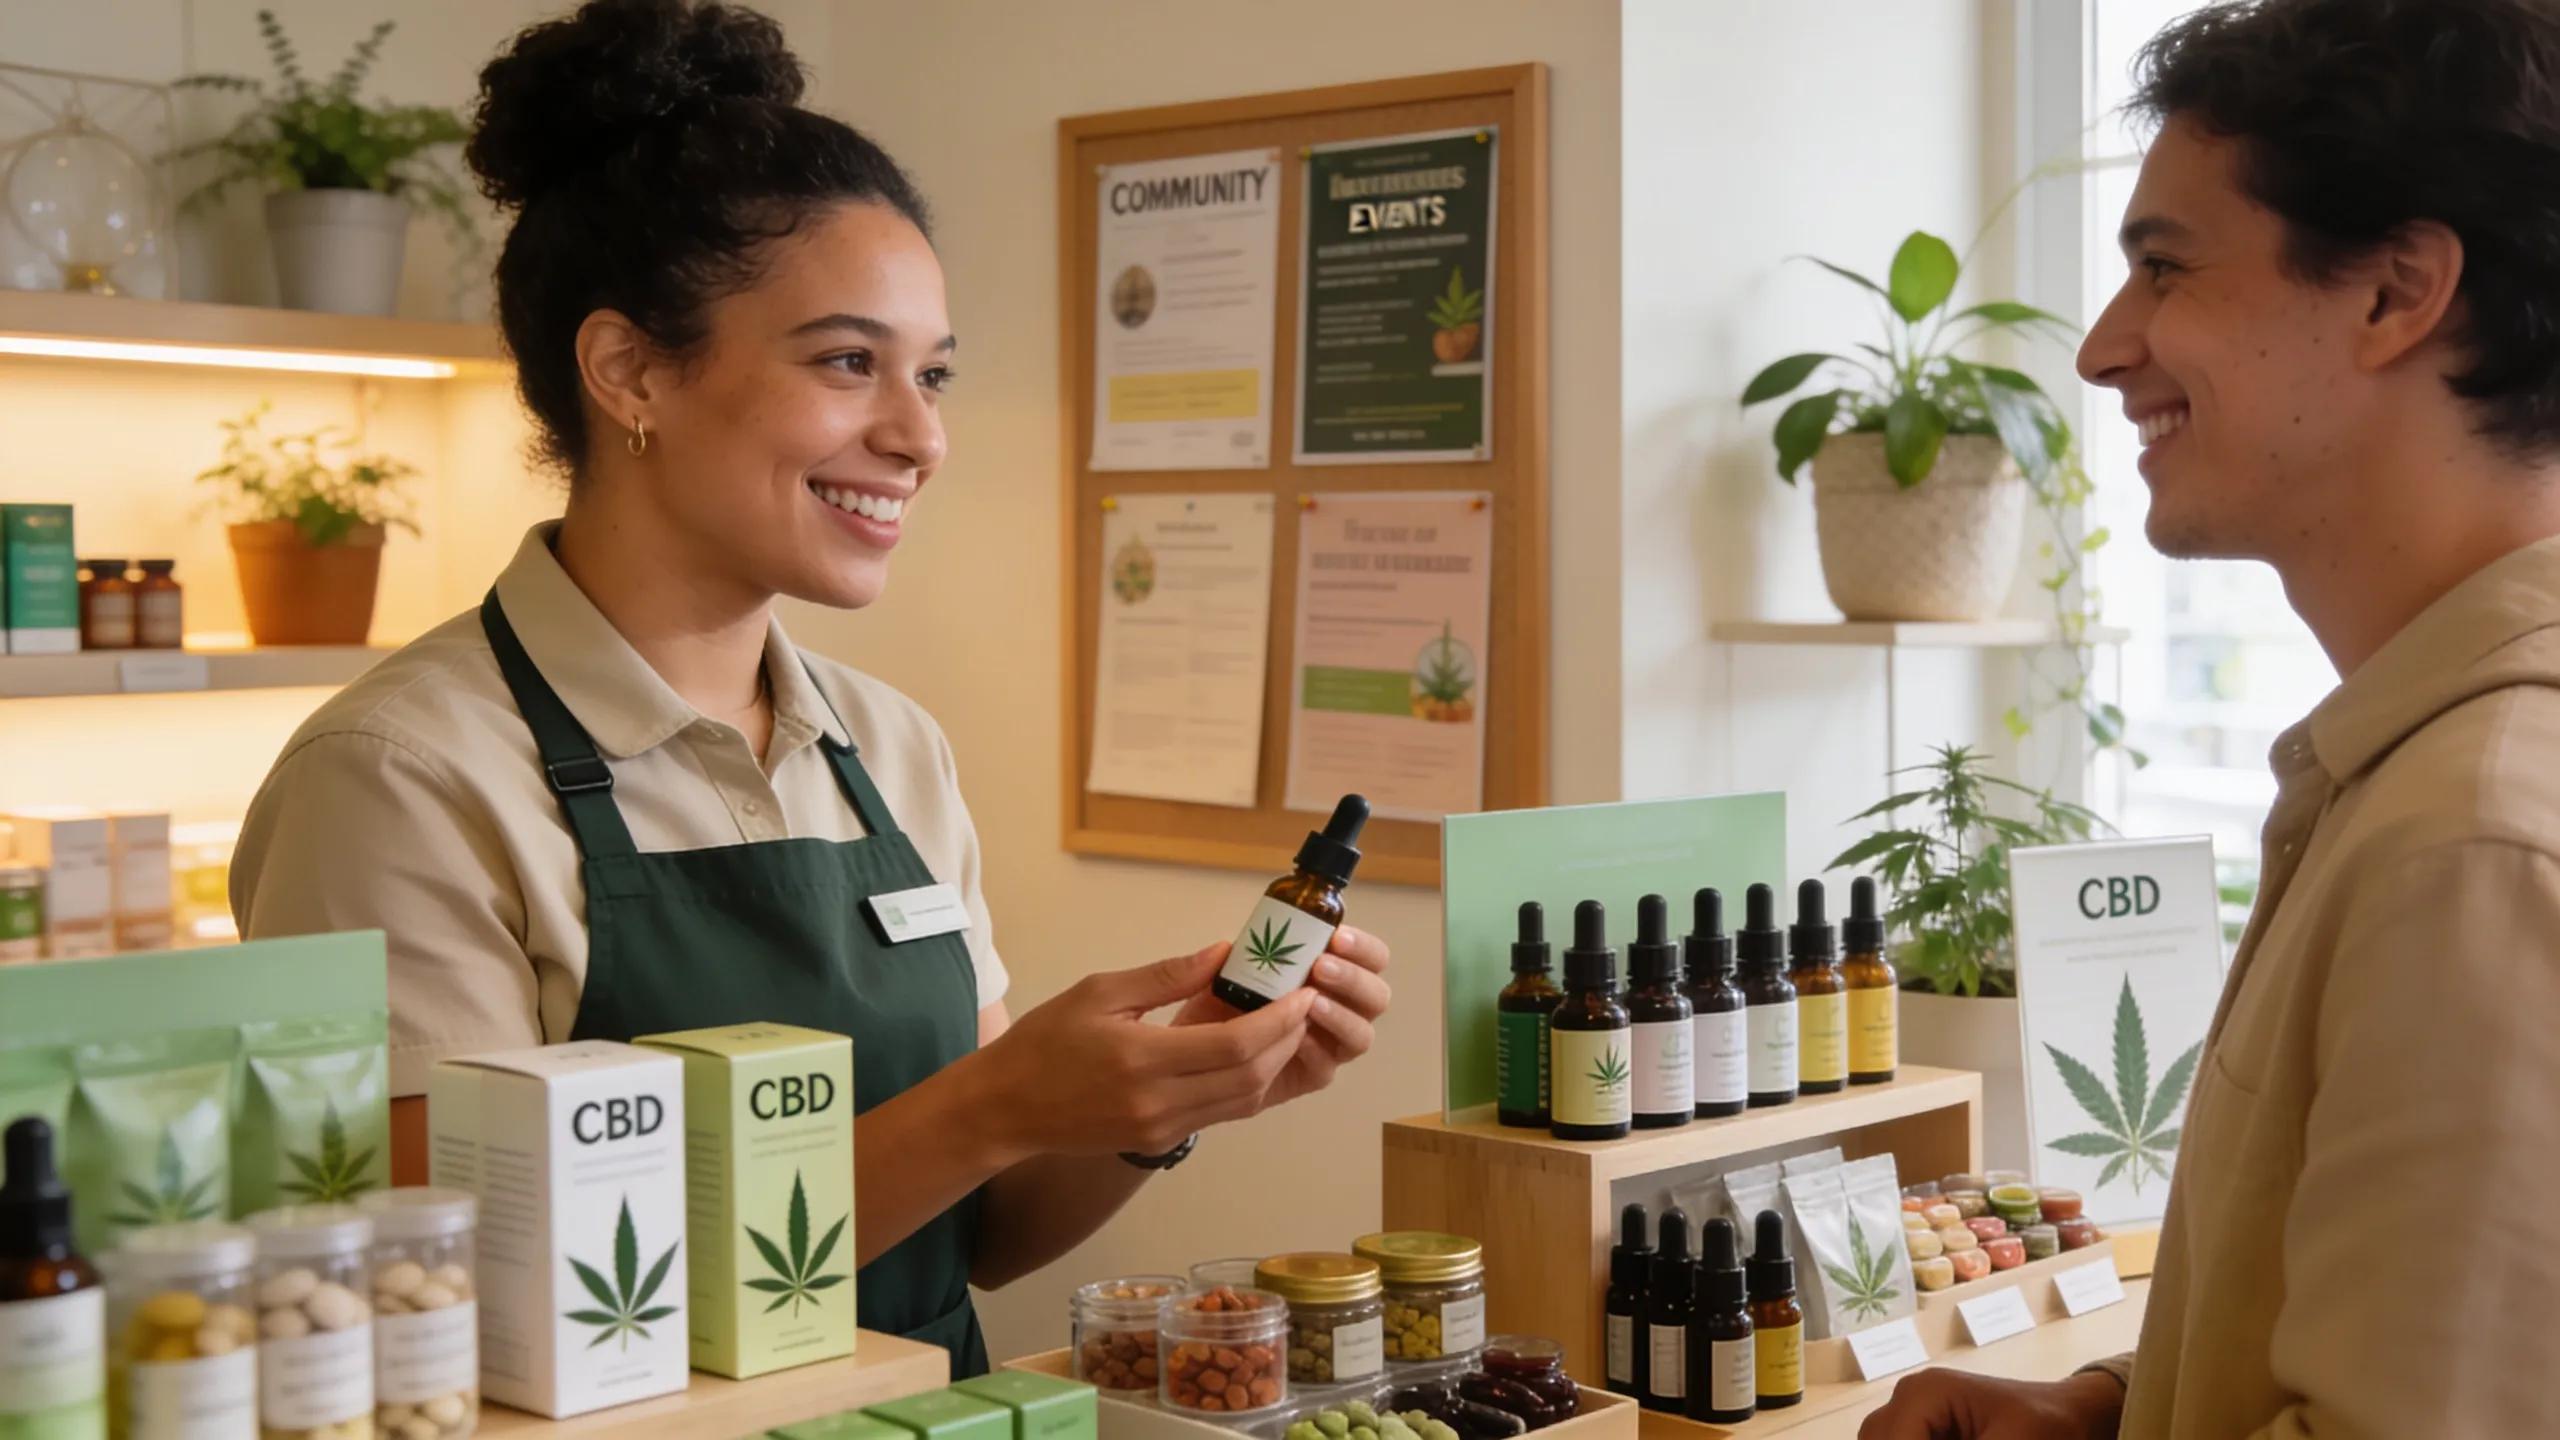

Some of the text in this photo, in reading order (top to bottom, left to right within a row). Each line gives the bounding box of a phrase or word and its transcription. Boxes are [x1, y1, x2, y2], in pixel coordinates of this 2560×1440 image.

[1110, 166, 1269, 215] COMMUNITY
[2078, 874, 2160, 920] CBD
[572, 1094, 664, 1145] CBD
[750, 1072, 835, 1121] CBD
